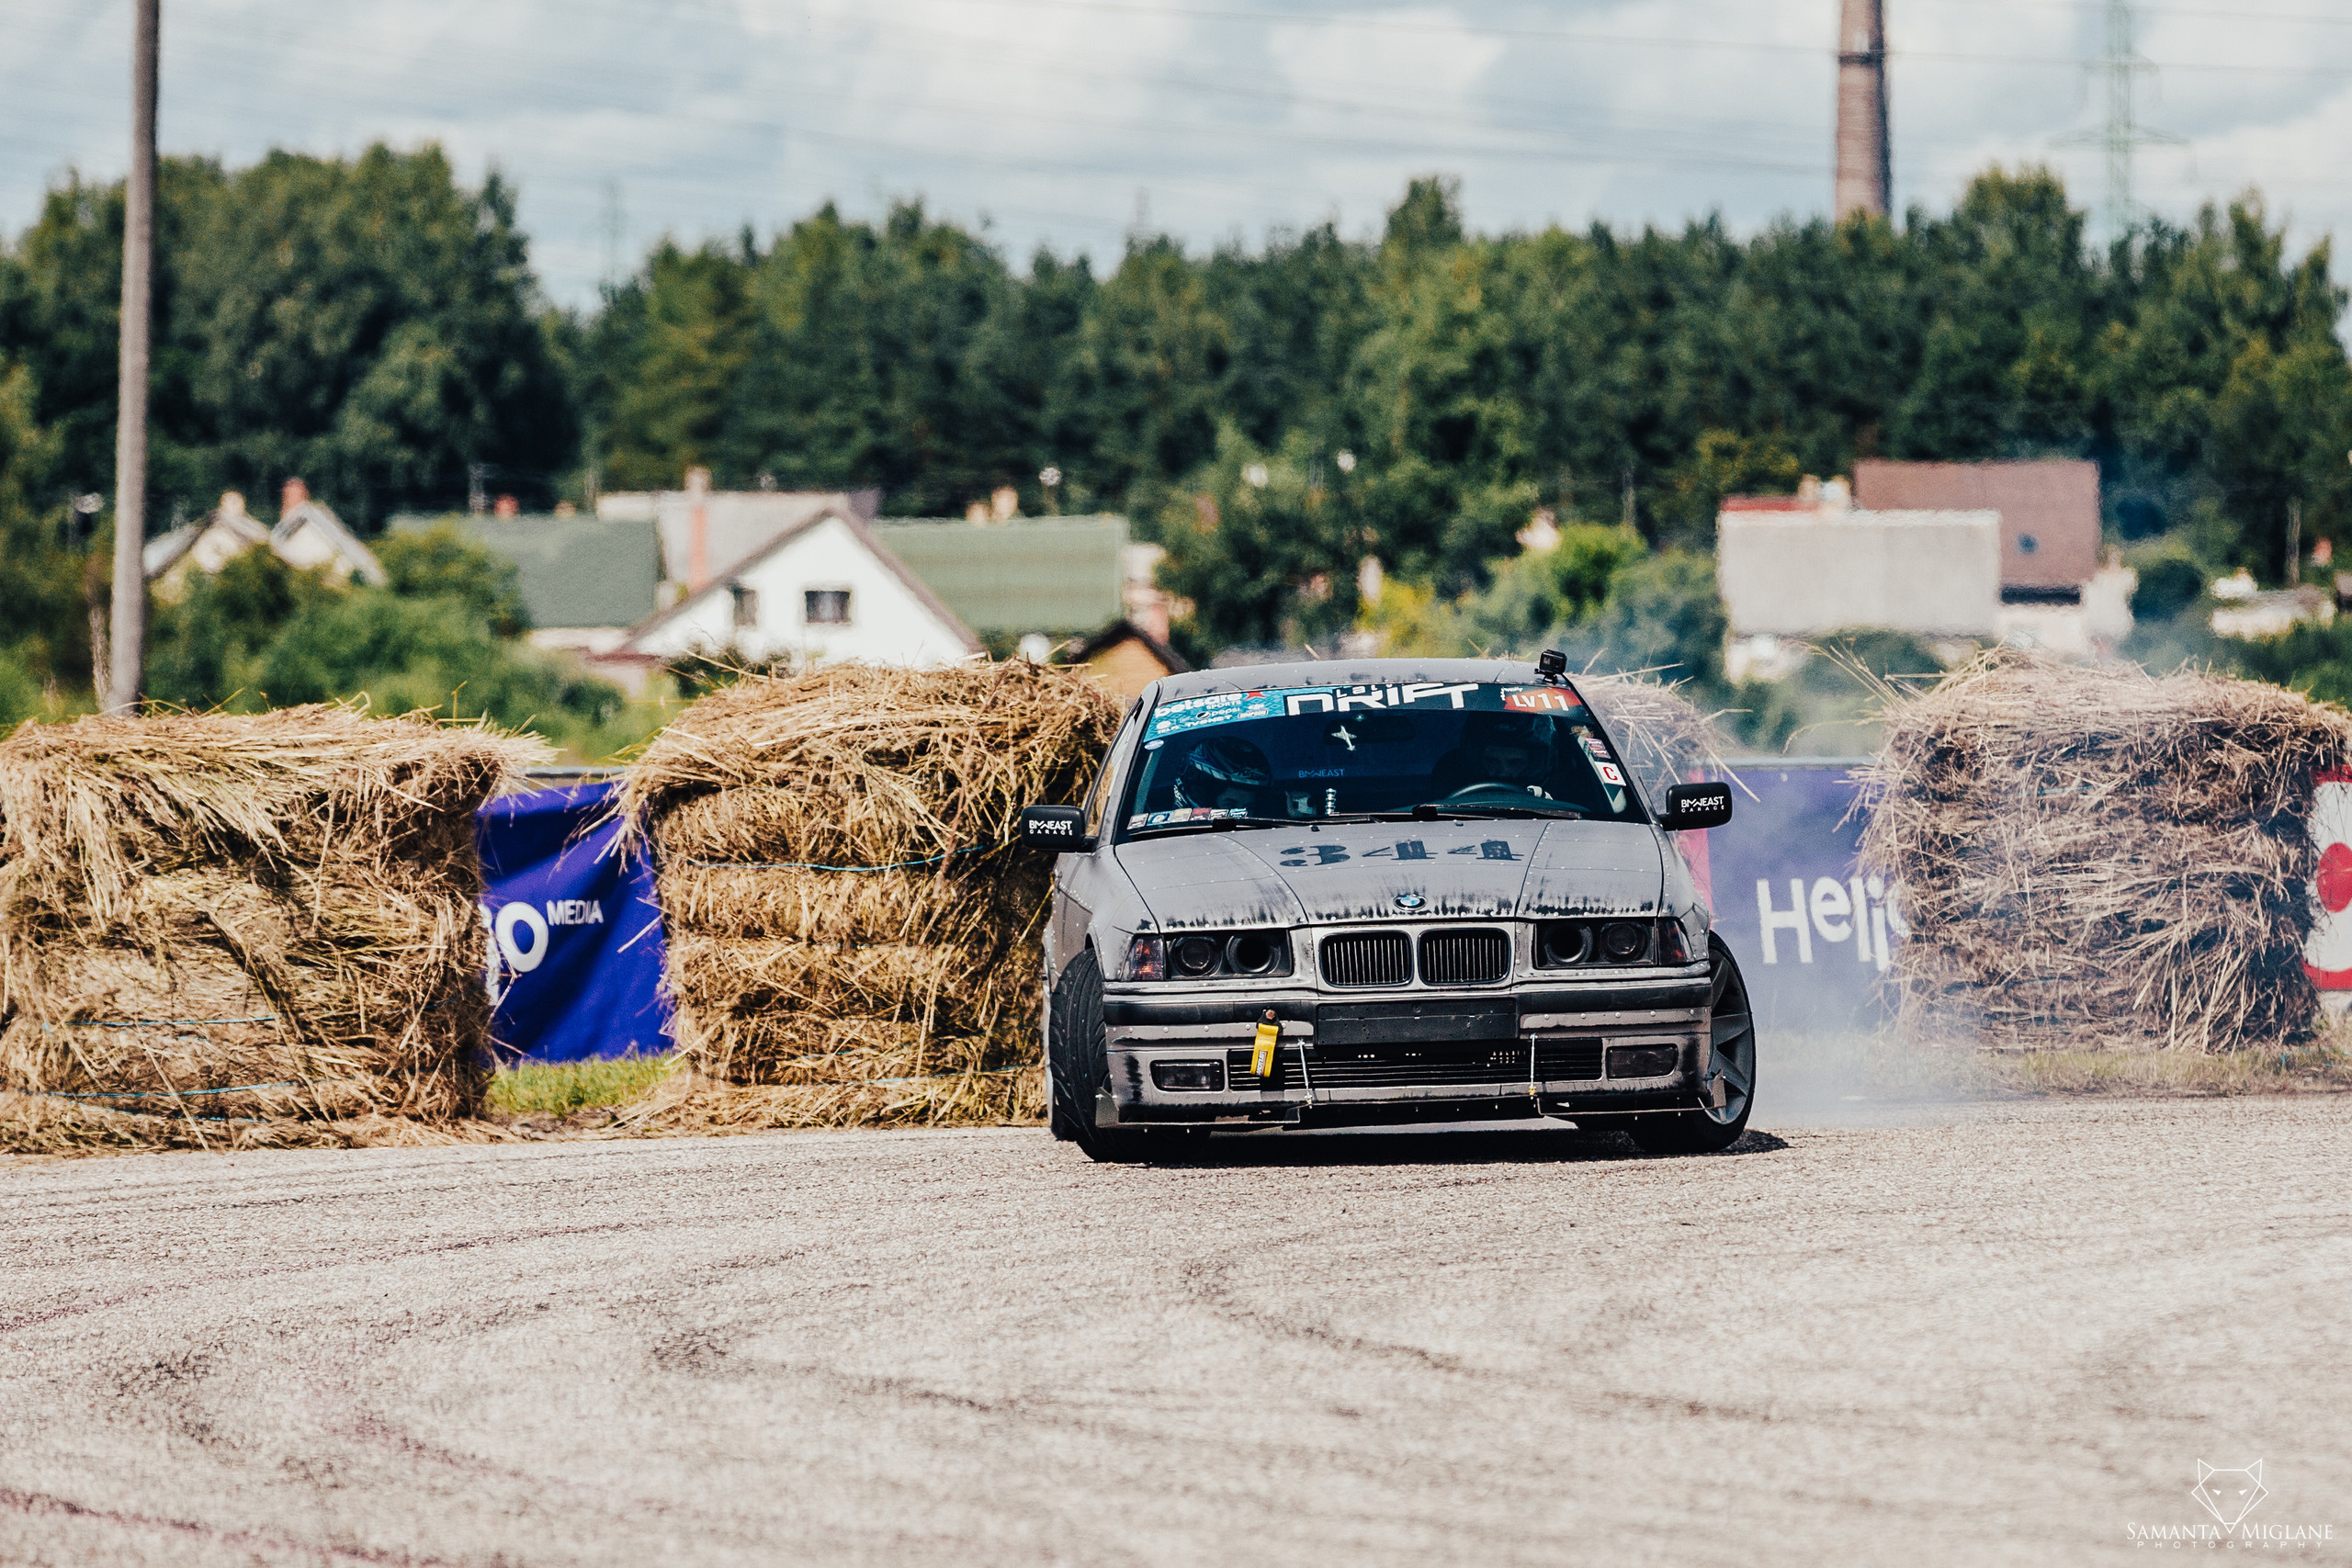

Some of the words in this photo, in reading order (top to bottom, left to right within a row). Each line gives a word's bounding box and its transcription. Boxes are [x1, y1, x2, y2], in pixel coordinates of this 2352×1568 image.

[1602, 766, 1618, 781] C
[1680, 805, 1724, 813] GARAGE
[1279, 839, 1524, 867] 344
[546, 899, 605, 927] MEDIA
